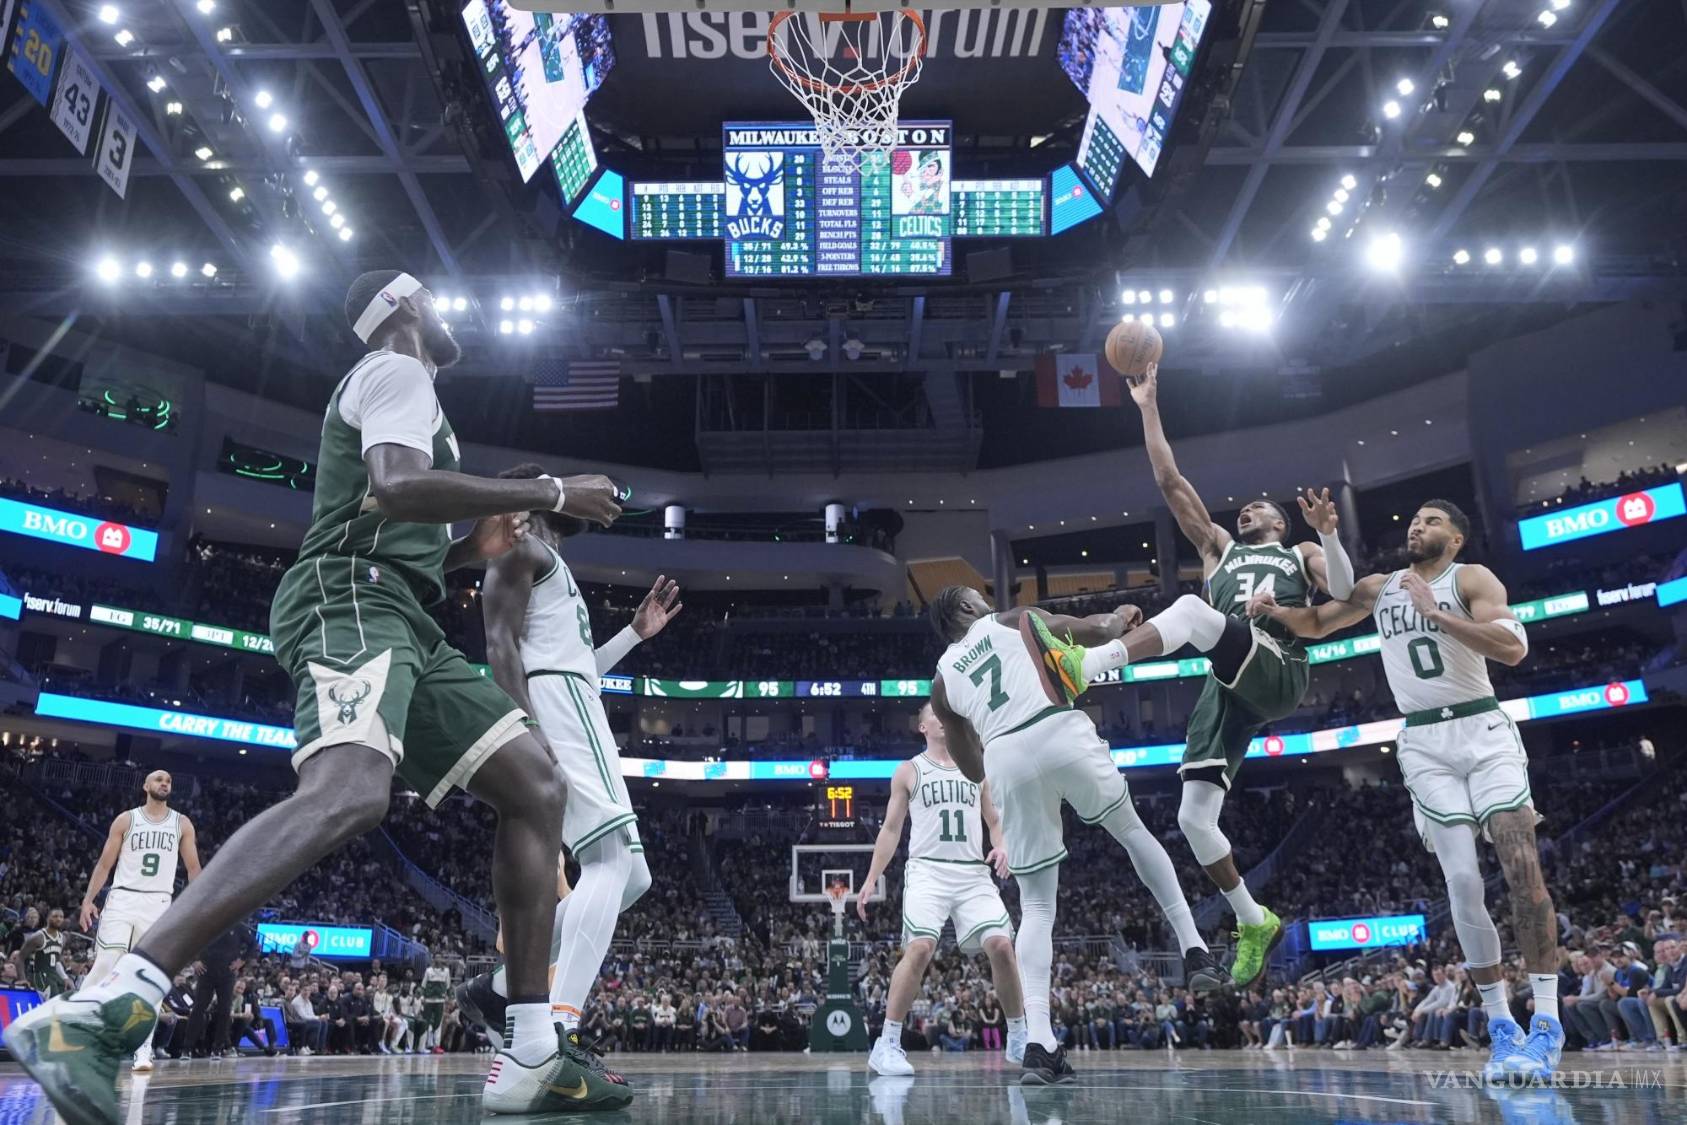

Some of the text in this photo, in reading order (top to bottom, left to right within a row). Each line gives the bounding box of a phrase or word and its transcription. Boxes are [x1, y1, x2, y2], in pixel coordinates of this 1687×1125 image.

[65, 83, 91, 127] 43
[109, 130, 127, 170] 3
[727, 217, 784, 239] BUCKS
[899, 216, 942, 237] CELTICS
[23, 510, 88, 540] BMO
[1545, 508, 1609, 538] BMO
[1224, 554, 1298, 576] MILWAUKEE
[1234, 573, 1275, 602] 34
[143, 616, 181, 635] 35/71
[953, 634, 993, 674] BROWN
[1407, 636, 1445, 680] 0
[758, 681, 779, 697] 95
[810, 682, 842, 696] 6:52
[861, 682, 876, 696] 4TH
[897, 681, 918, 696] 95
[969, 653, 1010, 712] 7
[1559, 692, 1601, 709] BMO
[159, 713, 219, 738] CARRY
[222, 722, 252, 743] THE
[827, 787, 853, 800] 6:52
[922, 780, 977, 809] CELTICS
[939, 809, 967, 843] 11
[131, 830, 176, 853] CELTICS
[140, 853, 161, 877] 9
[330, 935, 365, 948] CLUB
[1382, 924, 1418, 938] CLUB
